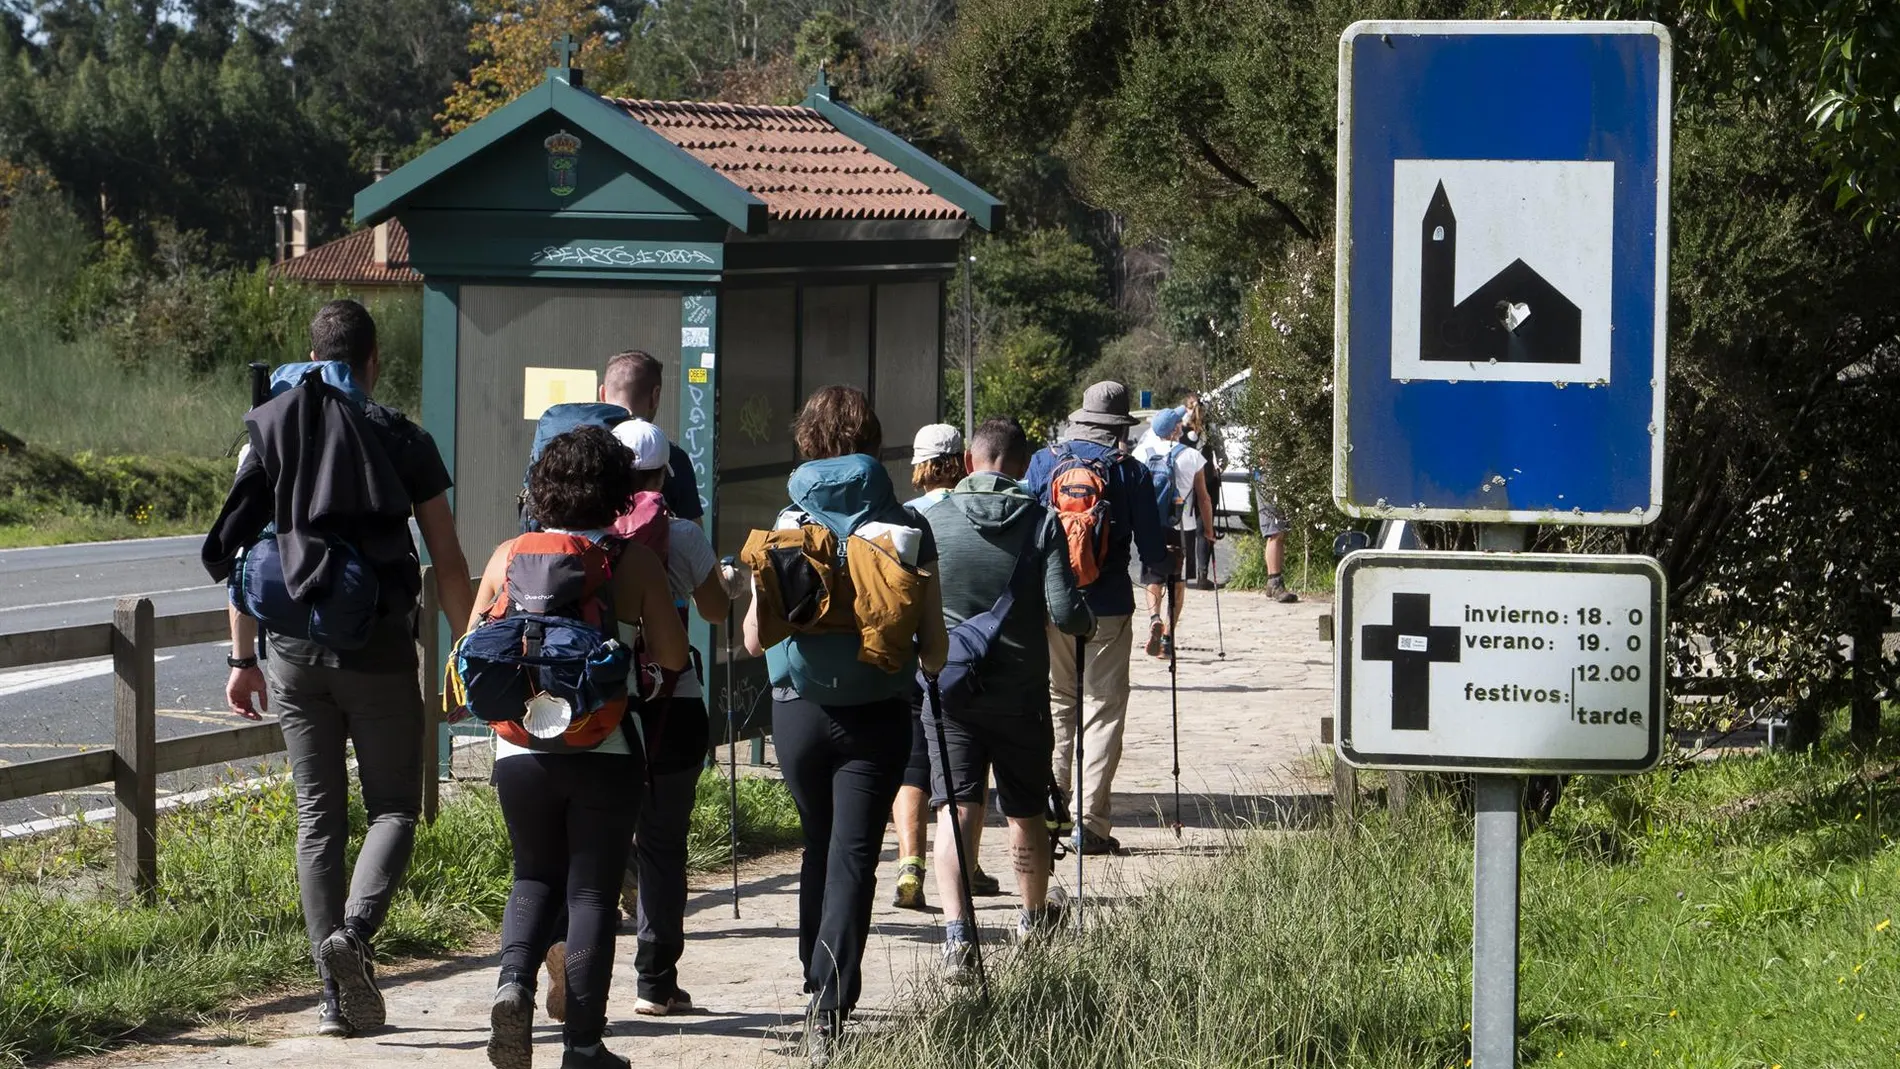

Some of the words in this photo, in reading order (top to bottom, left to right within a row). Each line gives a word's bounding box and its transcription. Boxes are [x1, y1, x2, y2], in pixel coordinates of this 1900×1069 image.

[1464, 604, 1569, 625] invierno:
[1465, 634, 1554, 650] verano:
[1577, 664, 1641, 682] 12.00
[1464, 682, 1570, 703] festivos:
[1577, 707, 1643, 725] tarde
